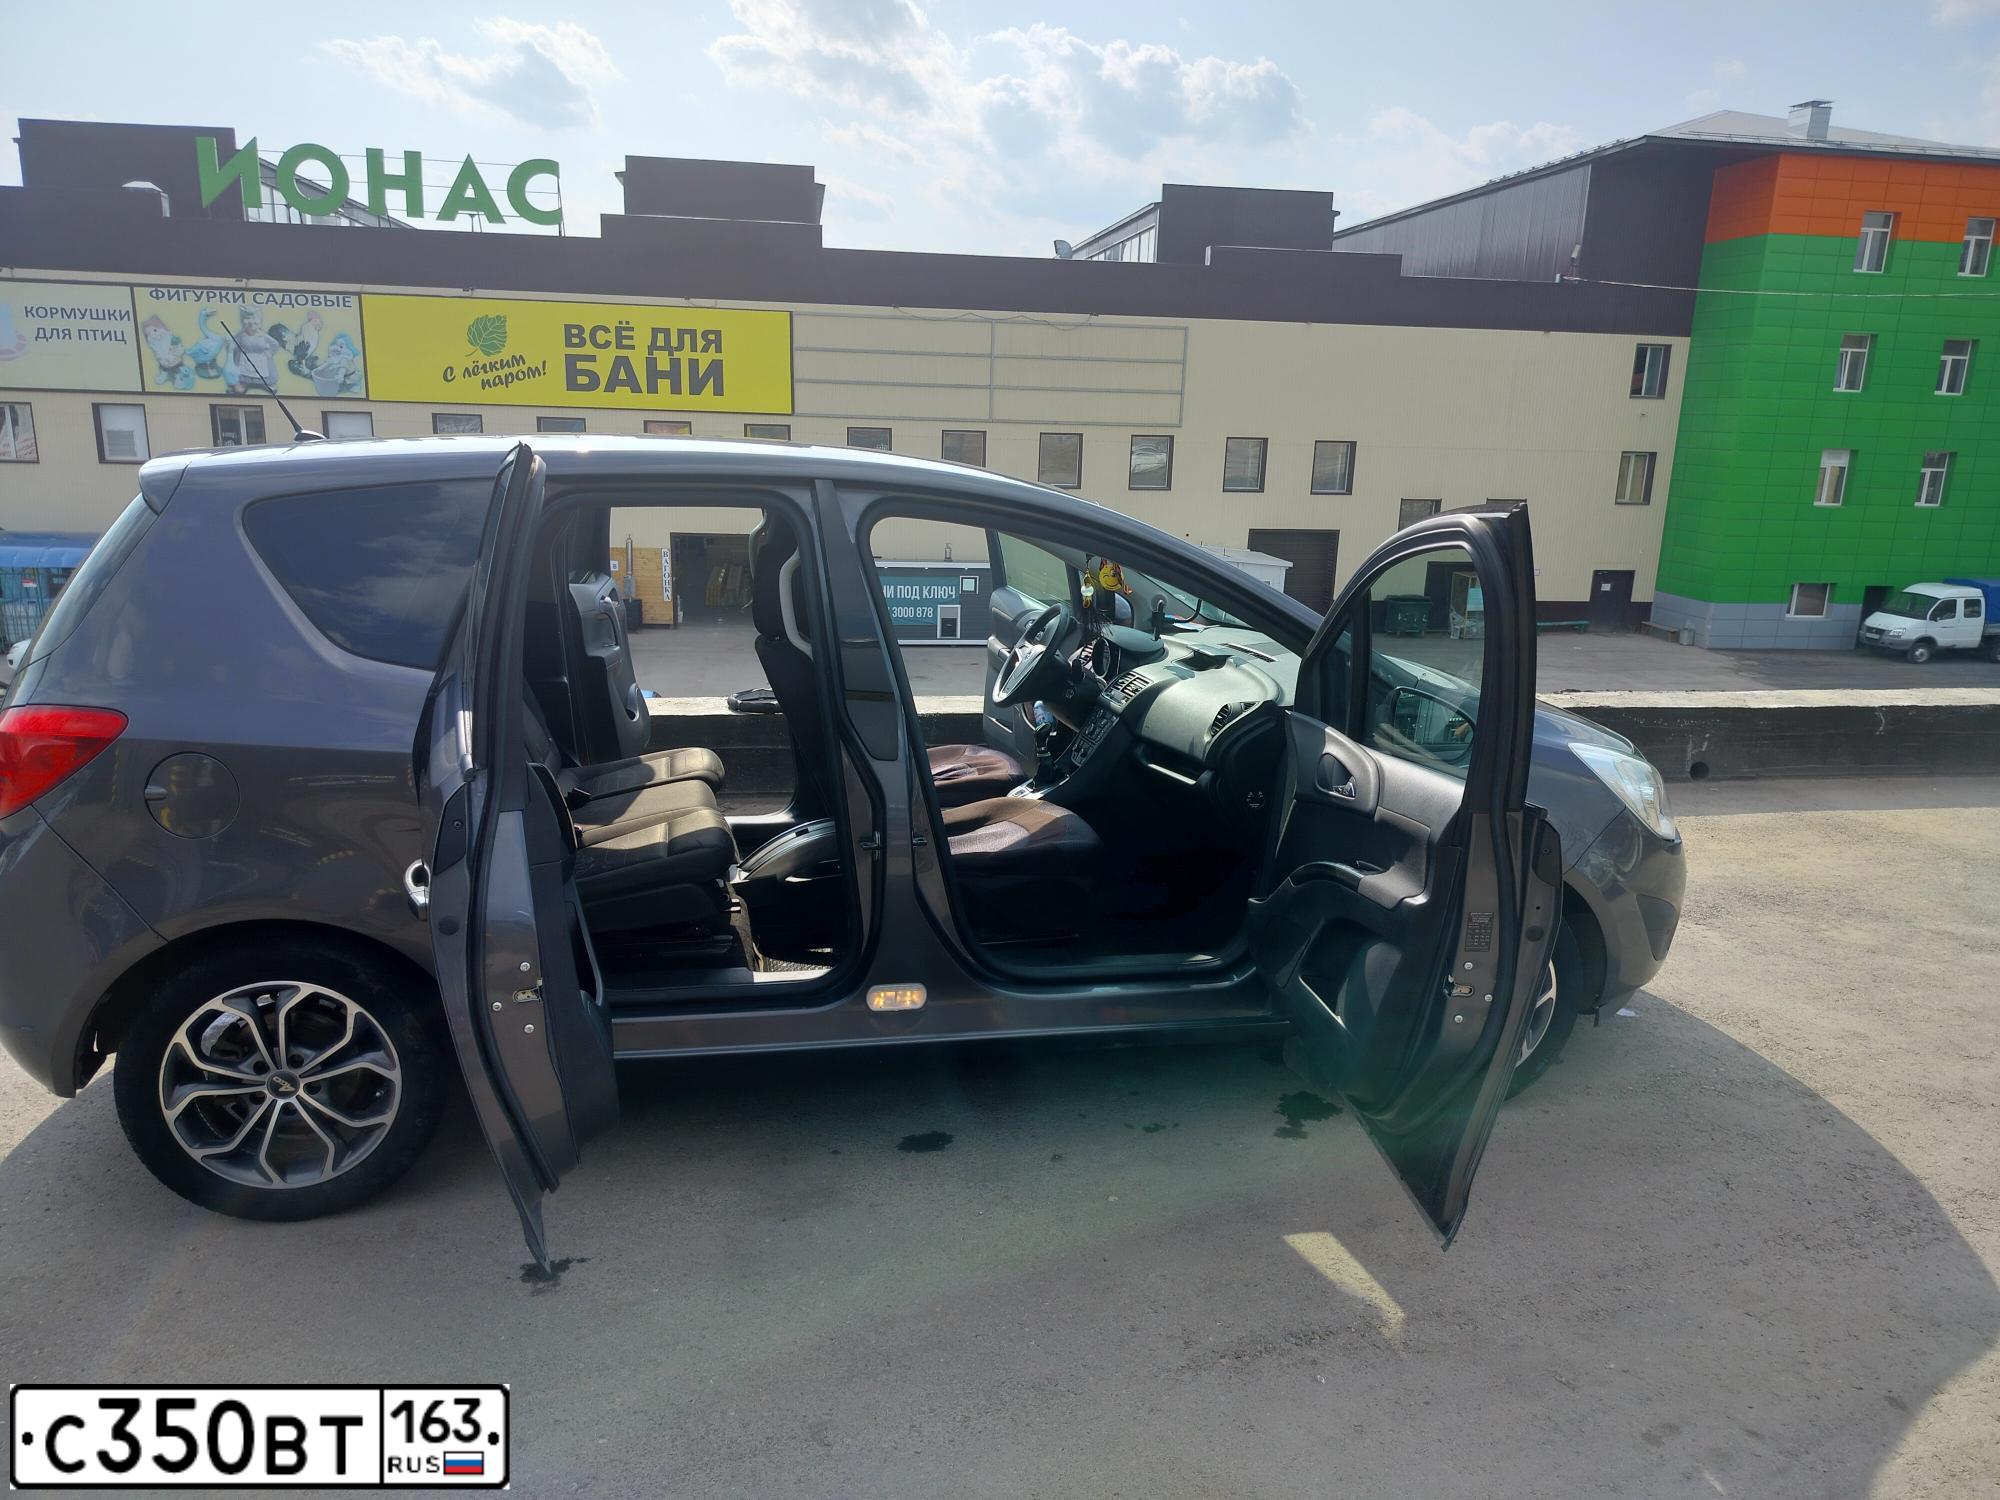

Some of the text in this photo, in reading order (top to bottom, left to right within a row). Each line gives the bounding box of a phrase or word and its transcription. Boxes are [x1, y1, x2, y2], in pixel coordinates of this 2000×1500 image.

[196, 136, 562, 226] ИОНАС
[149, 288, 353, 309] ФИГУРКИ САДОВЫЕ
[24, 305, 131, 322] КОРМУШКИ
[35, 327, 127, 344] ДЛЯ ПТИЦ
[564, 320, 723, 357] ВСЁ ДЛЯ
[463, 354, 527, 380] лёгким
[481, 360, 547, 391] паром!
[564, 353, 724, 396] БАНИ
[897, 585, 920, 600] ПОД
[923, 585, 956, 599] КЛЮЧ
[892, 606, 933, 618] 3000 878
